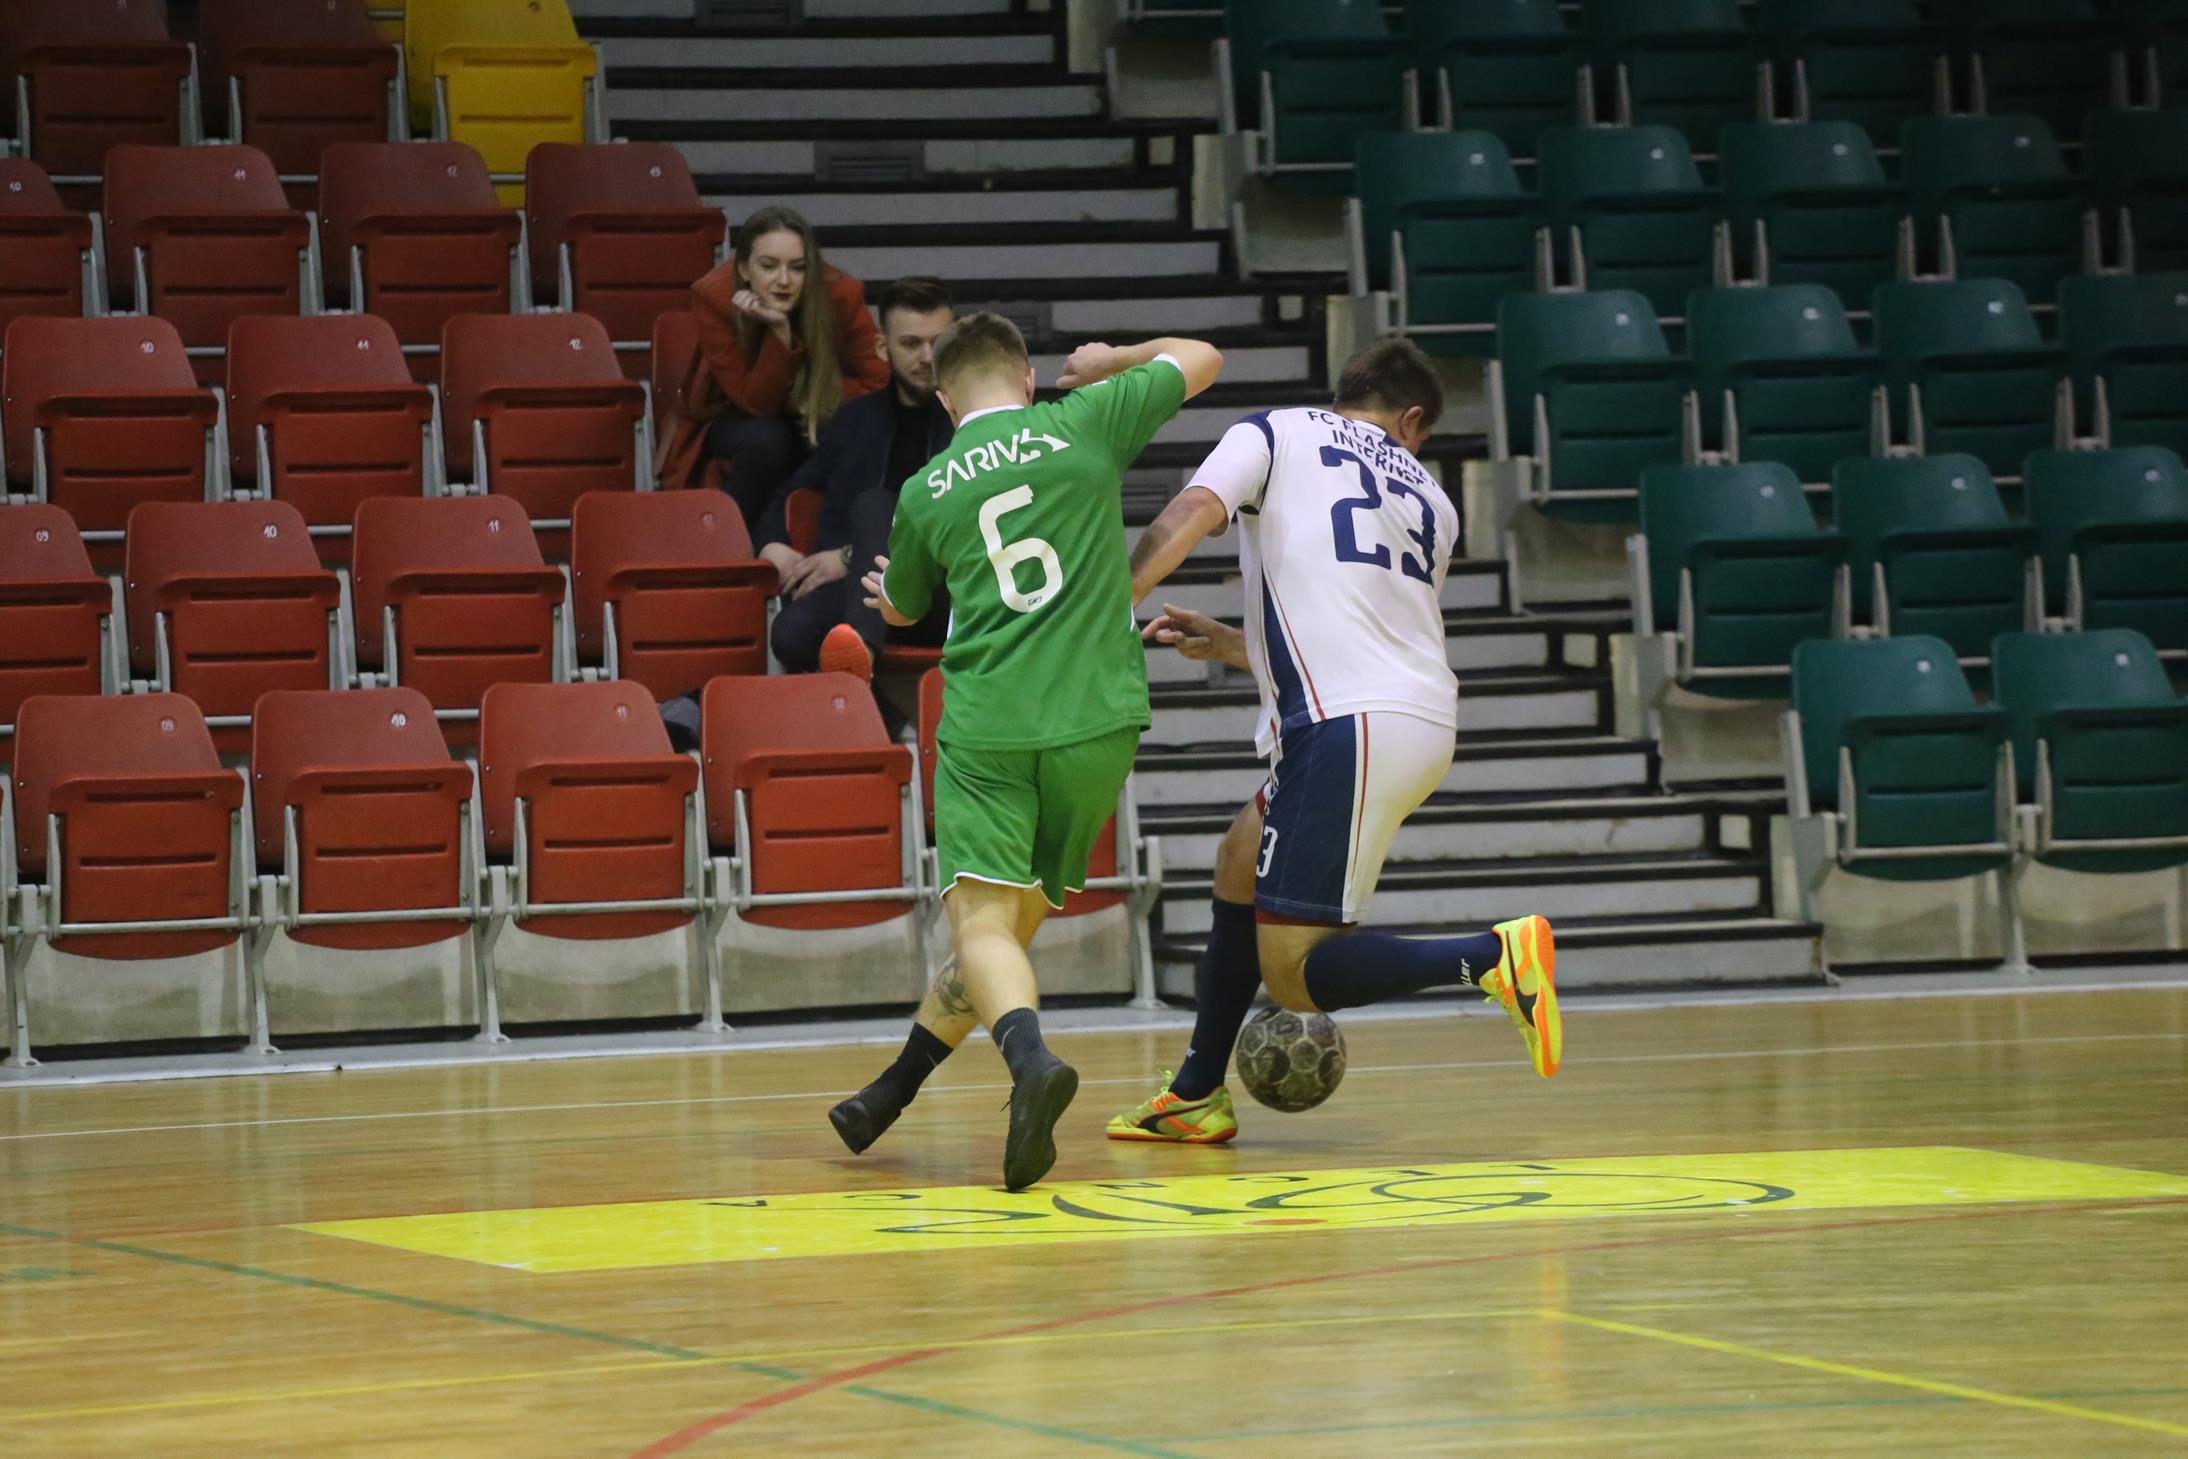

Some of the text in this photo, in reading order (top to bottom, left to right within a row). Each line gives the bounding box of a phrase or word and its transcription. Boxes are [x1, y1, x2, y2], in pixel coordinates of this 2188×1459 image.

[8, 181, 22, 192] 10
[140, 341, 155, 354] 10
[357, 339, 370, 352] 11
[569, 338, 584, 352] 12
[1306, 410, 1335, 426] FC
[1319, 445, 1436, 588] 23
[262, 524, 279, 539] 10
[487, 518, 500, 533] 11
[978, 484, 1063, 613] 6
[390, 712, 408, 728] 10
